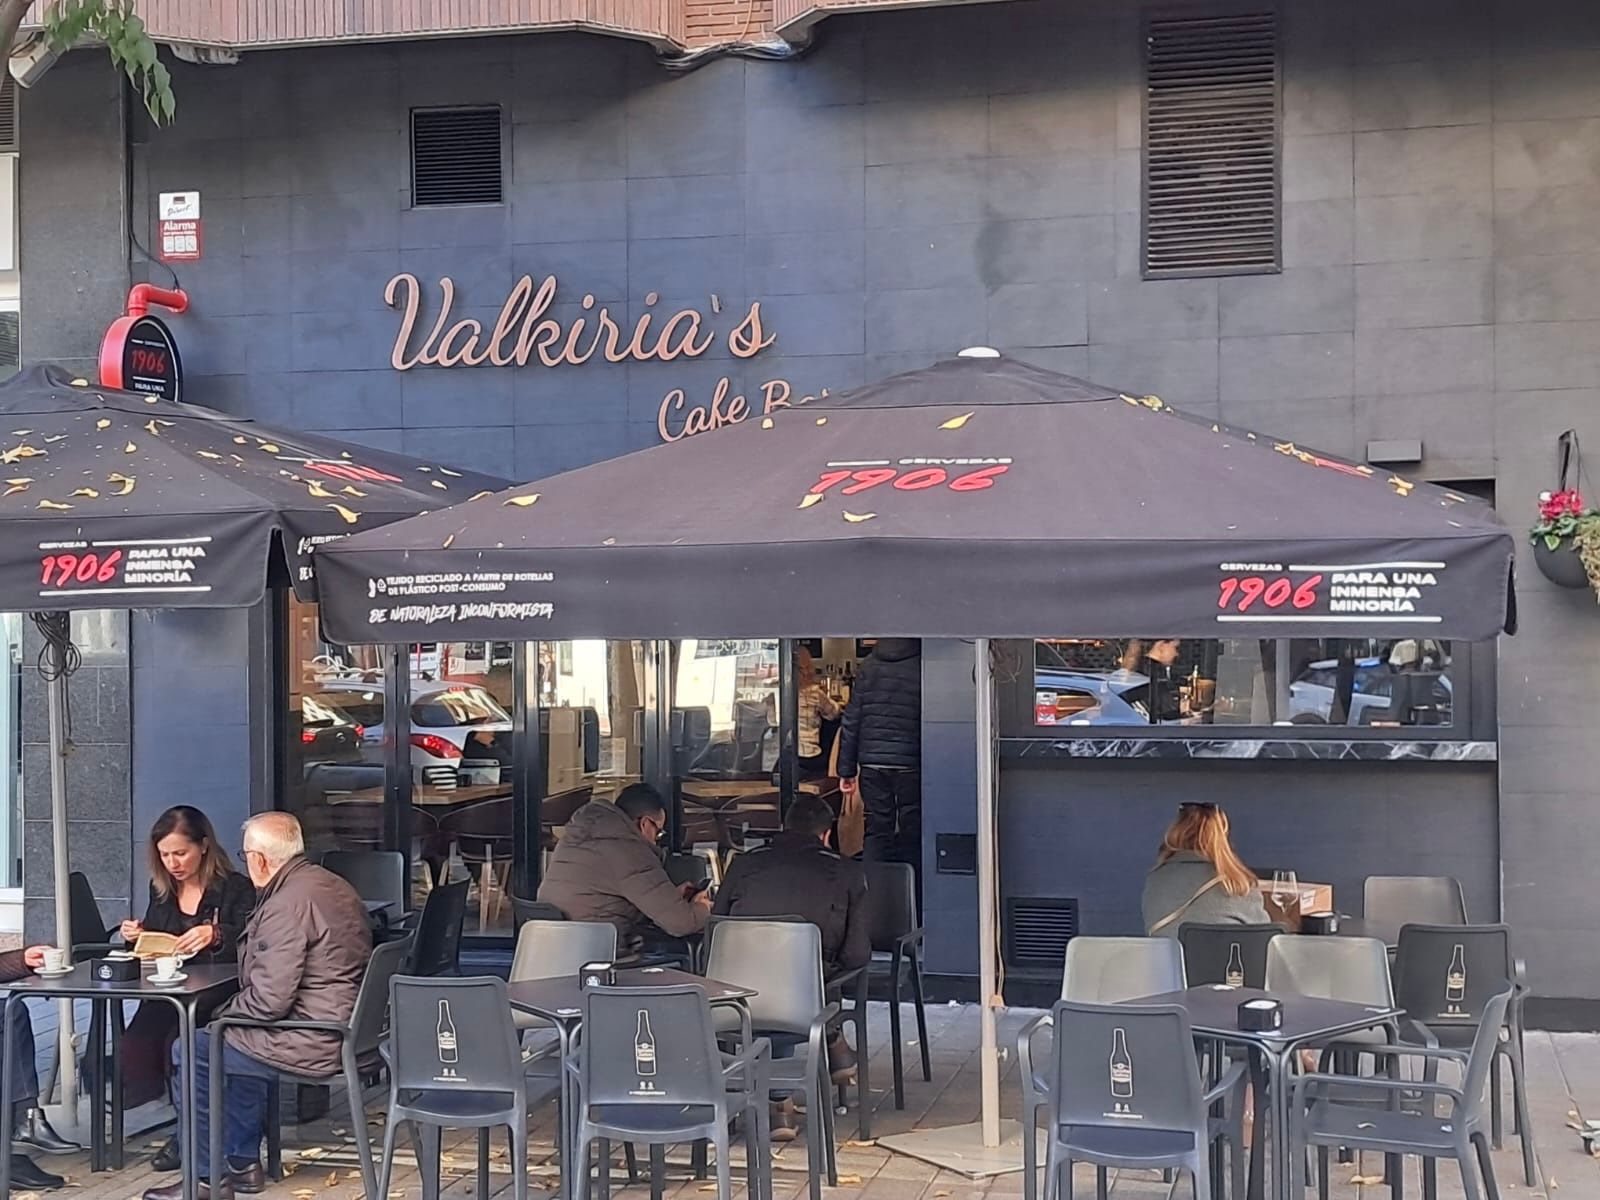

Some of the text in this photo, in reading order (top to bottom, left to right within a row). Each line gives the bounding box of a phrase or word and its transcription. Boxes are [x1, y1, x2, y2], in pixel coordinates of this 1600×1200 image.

[163, 220, 197, 231] Alarma
[384, 273, 776, 371] Valkiria's
[131, 349, 166, 374] 1906
[658, 377, 751, 442] Cafe
[809, 465, 1009, 495] 1906
[39, 541, 88, 549] CERVEZAS
[128, 546, 206, 559] PARA UNA
[41, 550, 122, 587] 1906
[125, 559, 196, 571] INMENSA
[1219, 563, 1283, 572] CERVEZAS
[124, 570, 192, 583] MINORÍA
[386, 572, 554, 585] TEJIDO RECICLADO A PARTIR DE BOTELLAS
[1331, 572, 1438, 585] PARA UNA
[387, 582, 506, 596] DE PLÁSTICO POST-CONSUMO
[1218, 574, 1323, 611] 1906
[1330, 586, 1422, 599] INMENSA
[457, 602, 555, 621] INCONFORMISTA
[1329, 598, 1415, 612] MINORÍA
